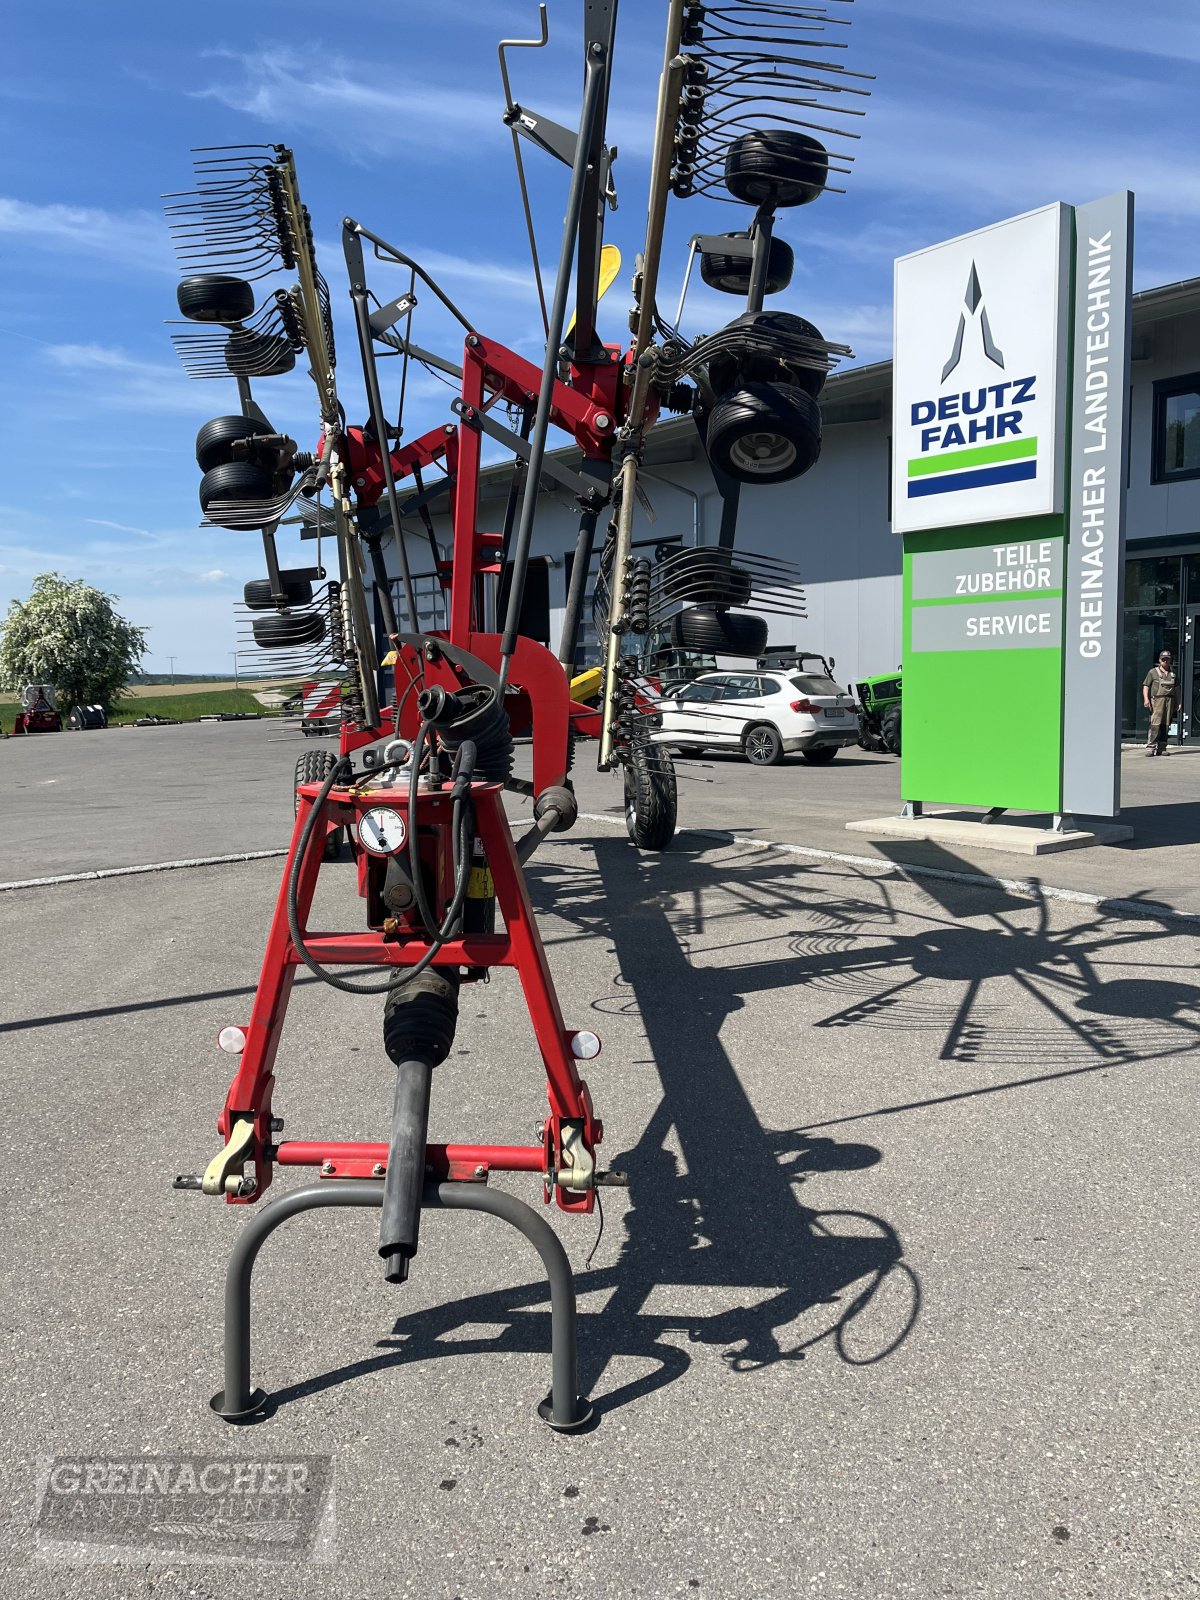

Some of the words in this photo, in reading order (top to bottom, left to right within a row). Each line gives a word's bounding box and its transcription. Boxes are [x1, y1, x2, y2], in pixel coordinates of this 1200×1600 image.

[1084, 230, 1112, 454] LANDTECHNIK
[911, 376, 1036, 427] DEUTZ
[921, 410, 1022, 452] FAHR
[993, 542, 1052, 567] TEILE
[1079, 466, 1106, 658] GREINACHER
[955, 563, 1051, 595] ZUBEHÖR
[966, 612, 1051, 636] SERVICE
